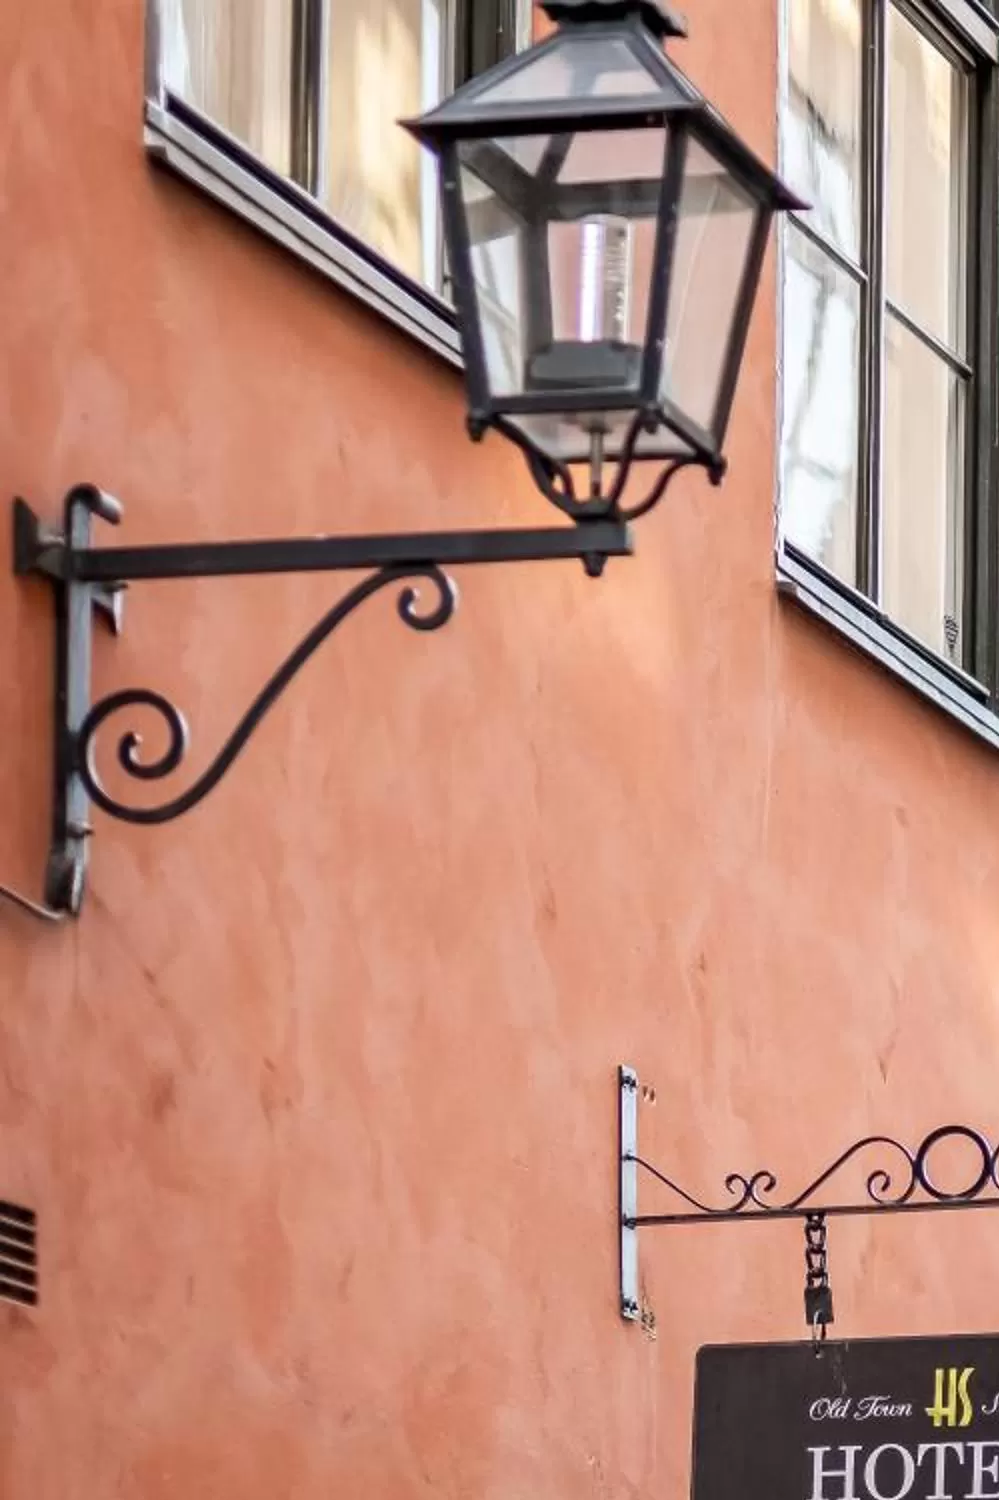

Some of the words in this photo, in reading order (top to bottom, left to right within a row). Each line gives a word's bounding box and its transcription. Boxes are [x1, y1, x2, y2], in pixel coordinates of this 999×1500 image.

[808, 1396, 848, 1421] Old
[854, 1394, 912, 1420] Town
[925, 1367, 975, 1427] HS
